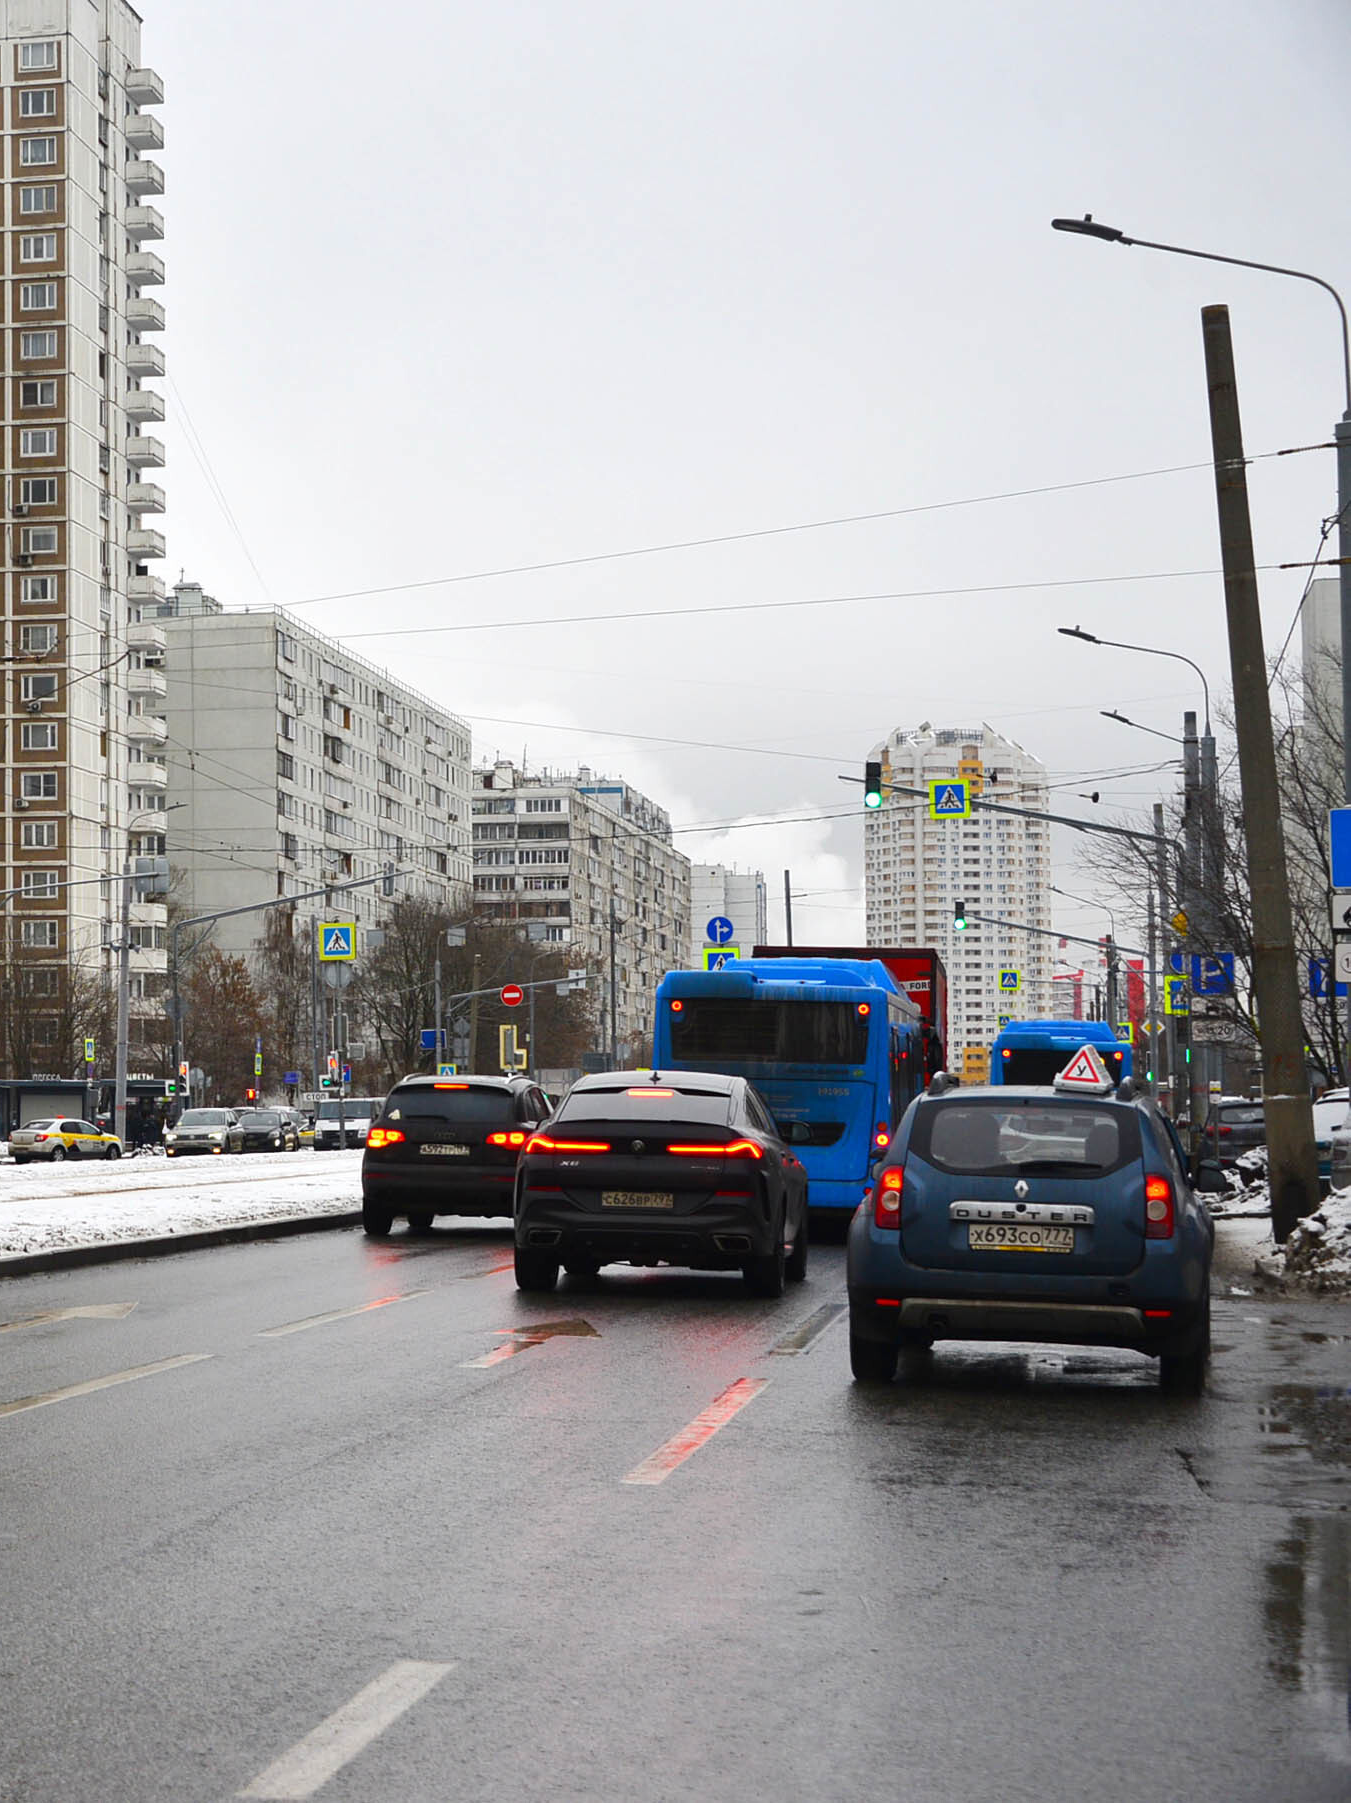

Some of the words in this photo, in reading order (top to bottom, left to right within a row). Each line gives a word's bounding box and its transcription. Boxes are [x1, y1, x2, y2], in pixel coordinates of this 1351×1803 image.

[32, 1073, 61, 1081] ПРЕССА
[126, 1073, 154, 1081] ЦВЕТЫ
[305, 1093, 327, 1101] СТОП
[956, 1209, 1088, 1222] DUSTER
[1044, 1227, 1070, 1241] 777
